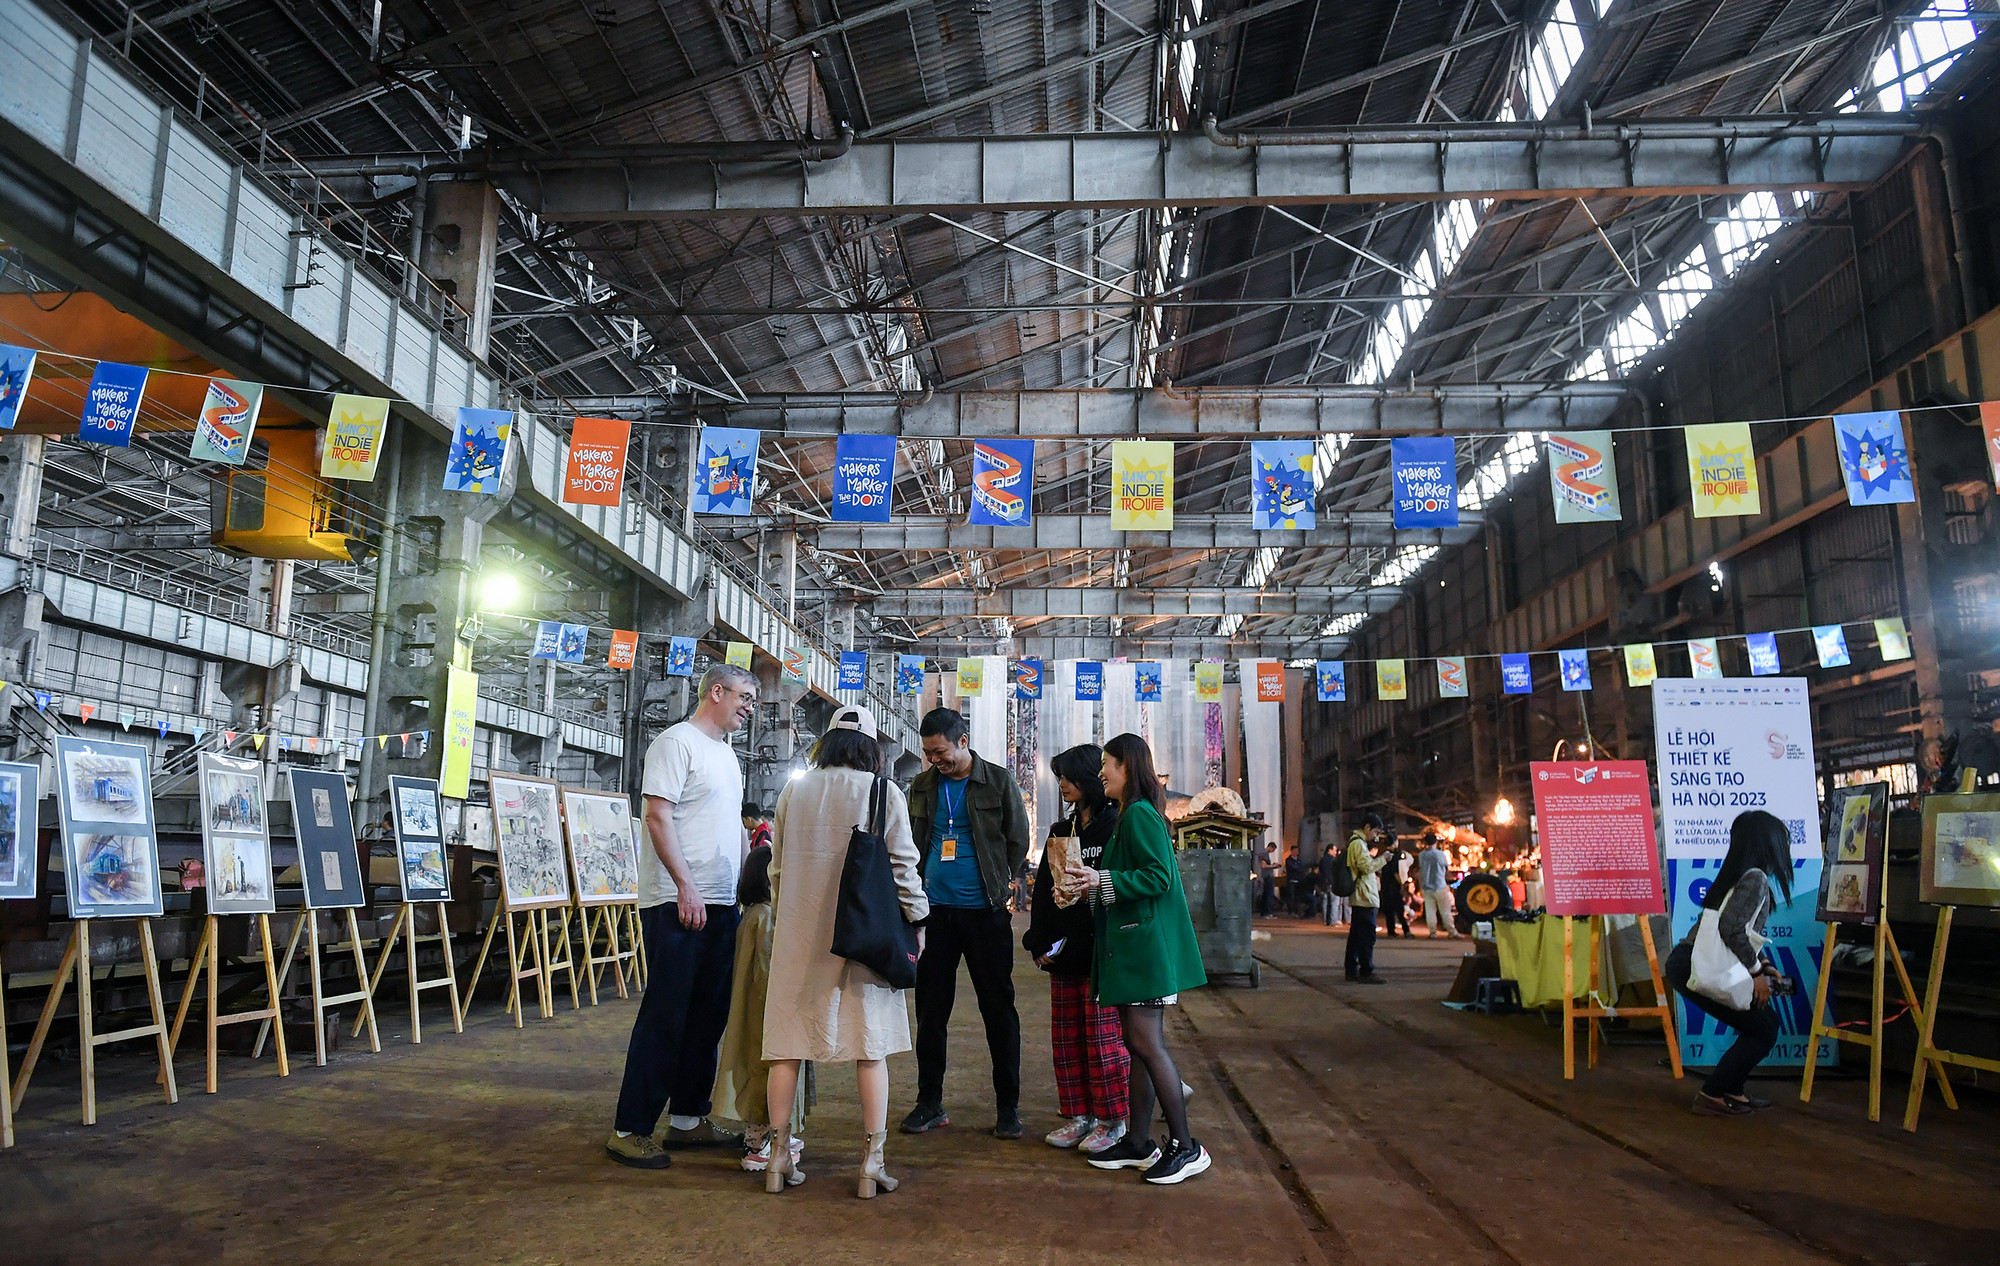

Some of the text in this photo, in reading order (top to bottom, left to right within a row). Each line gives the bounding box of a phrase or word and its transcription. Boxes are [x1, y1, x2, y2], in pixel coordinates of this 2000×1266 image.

[98, 417, 126, 431] DOTS
[336, 422, 375, 437] HANOI
[332, 447, 370, 462] TROUPE
[1122, 470, 1164, 483] HANOI
[584, 478, 614, 492] DOTS
[1702, 481, 1748, 496] TROUPE
[852, 493, 883, 506] DOTS
[1121, 497, 1164, 511] TROUPE
[1415, 499, 1449, 513] DOTS
[1668, 727, 1715, 747] LỄ HỘI
[1669, 747, 1733, 765] THIẾT KẾ
[1670, 769, 1745, 787] SÁNG TẠO
[1672, 789, 1766, 807] HÀ NỘI 2023
[1687, 818, 1704, 826] NHÀ
[1706, 818, 1723, 826] MÁY
[1771, 926, 1793, 938] 3B2
[1690, 1044, 1704, 1058] 17
